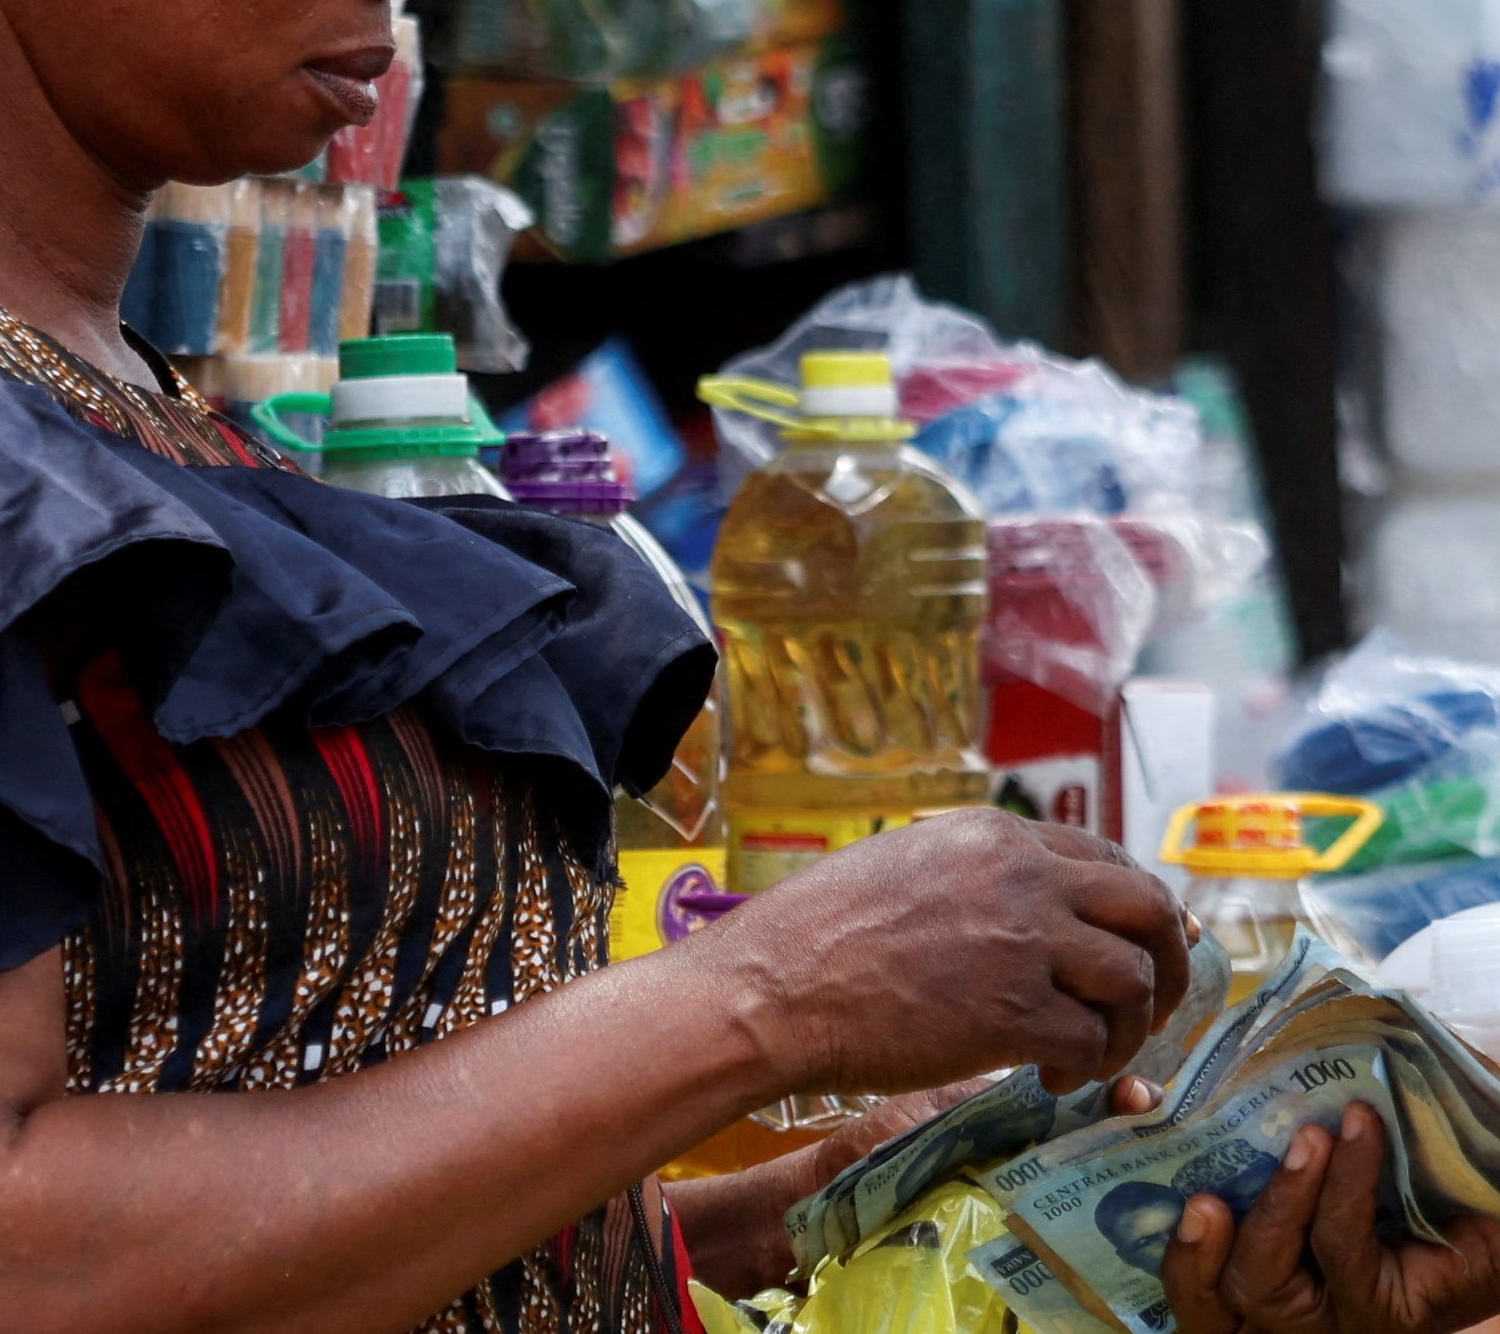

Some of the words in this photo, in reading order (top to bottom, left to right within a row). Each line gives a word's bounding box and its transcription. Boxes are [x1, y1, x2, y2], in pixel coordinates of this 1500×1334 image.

[1289, 1057, 1357, 1095] 1000
[1031, 1164, 1118, 1213] CENTRAL
[1121, 1147, 1172, 1175] BANK
[1176, 1137, 1202, 1156] OF
[1206, 1084, 1284, 1140] NIGERIA
[1041, 1195, 1084, 1223] 1000
[1008, 1262, 1057, 1297] 000
